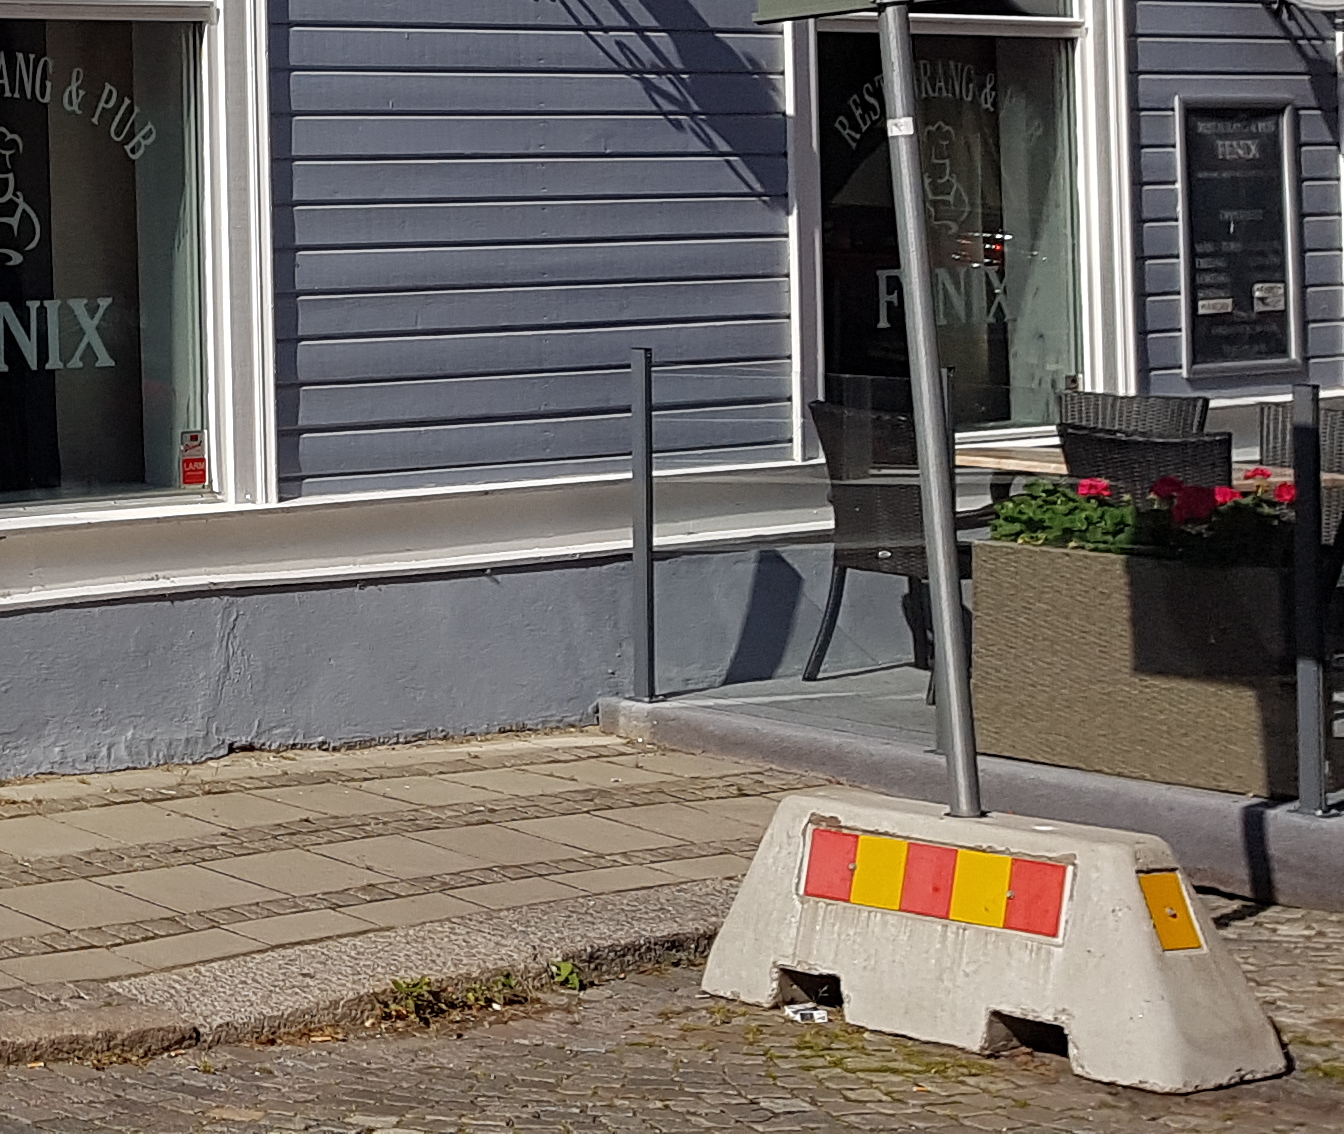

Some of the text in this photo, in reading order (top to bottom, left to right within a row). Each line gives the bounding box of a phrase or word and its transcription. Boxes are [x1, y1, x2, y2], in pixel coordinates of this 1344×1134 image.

[62, 67, 86, 114] &
[91, 82, 157, 160] PUB
[833, 59, 974, 150] RESRANG
[981, 72, 996, 112] &
[875, 266, 1018, 329] FNIX
